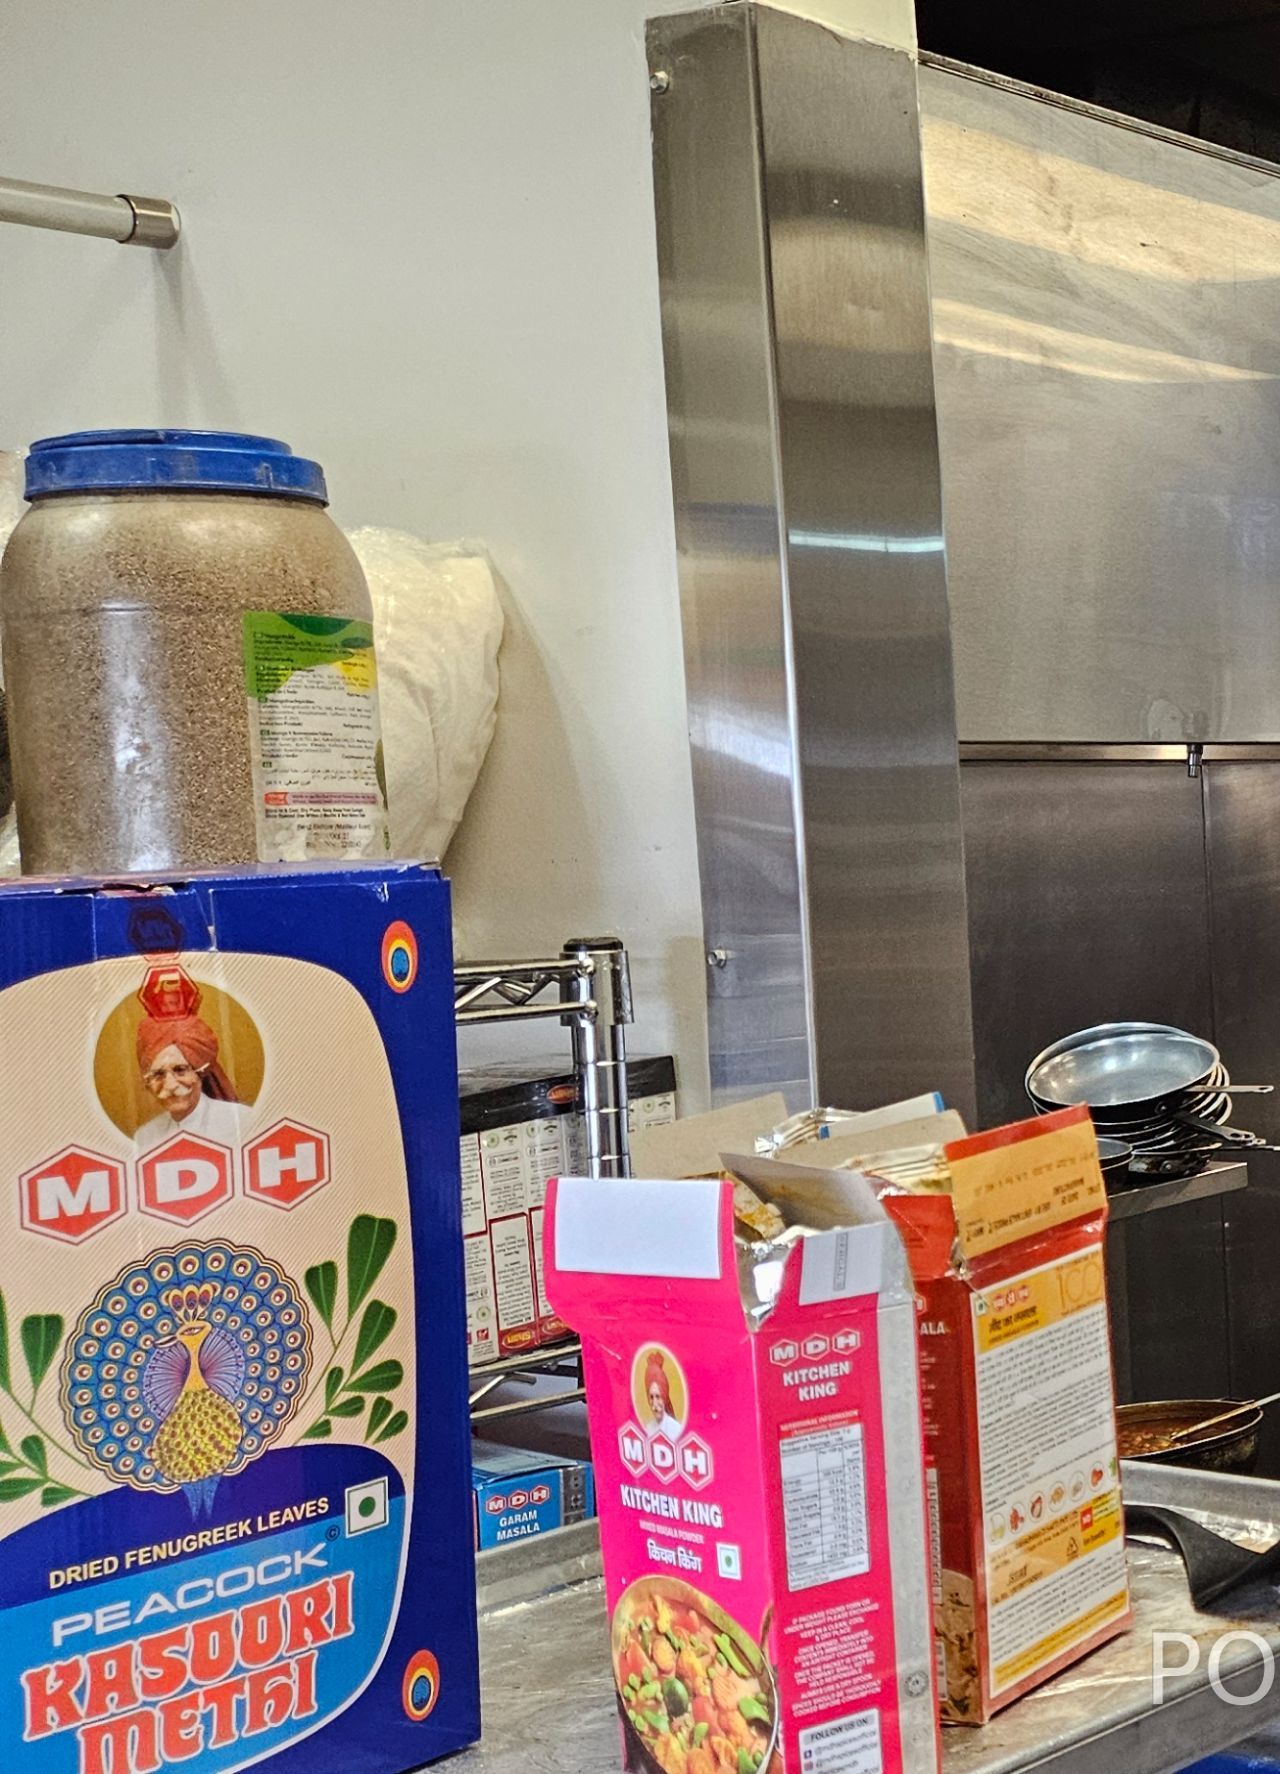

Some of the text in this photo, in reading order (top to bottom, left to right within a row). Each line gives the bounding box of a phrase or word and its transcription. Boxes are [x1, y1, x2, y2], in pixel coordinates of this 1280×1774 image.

[37, 1142, 317, 1221] MDH
[920, 1321, 945, 1335] ALA
[773, 1333, 857, 1361] MDH
[782, 1360, 852, 1387] KITCHEN
[798, 1381, 838, 1402] KING
[622, 1436, 707, 1475] MDH
[488, 1488, 547, 1511] MDH
[620, 1483, 724, 1529] KITCHEN KING
[496, 1522, 540, 1541] MASALA
[499, 1509, 537, 1528] GARAM
[48, 1496, 330, 1590] DRIED FENUGREEK LEAVES
[52, 1541, 329, 1648] PEACOCK
[20, 1570, 356, 1743] KASOORI
[809, 1725, 844, 1743] FOLLOW
